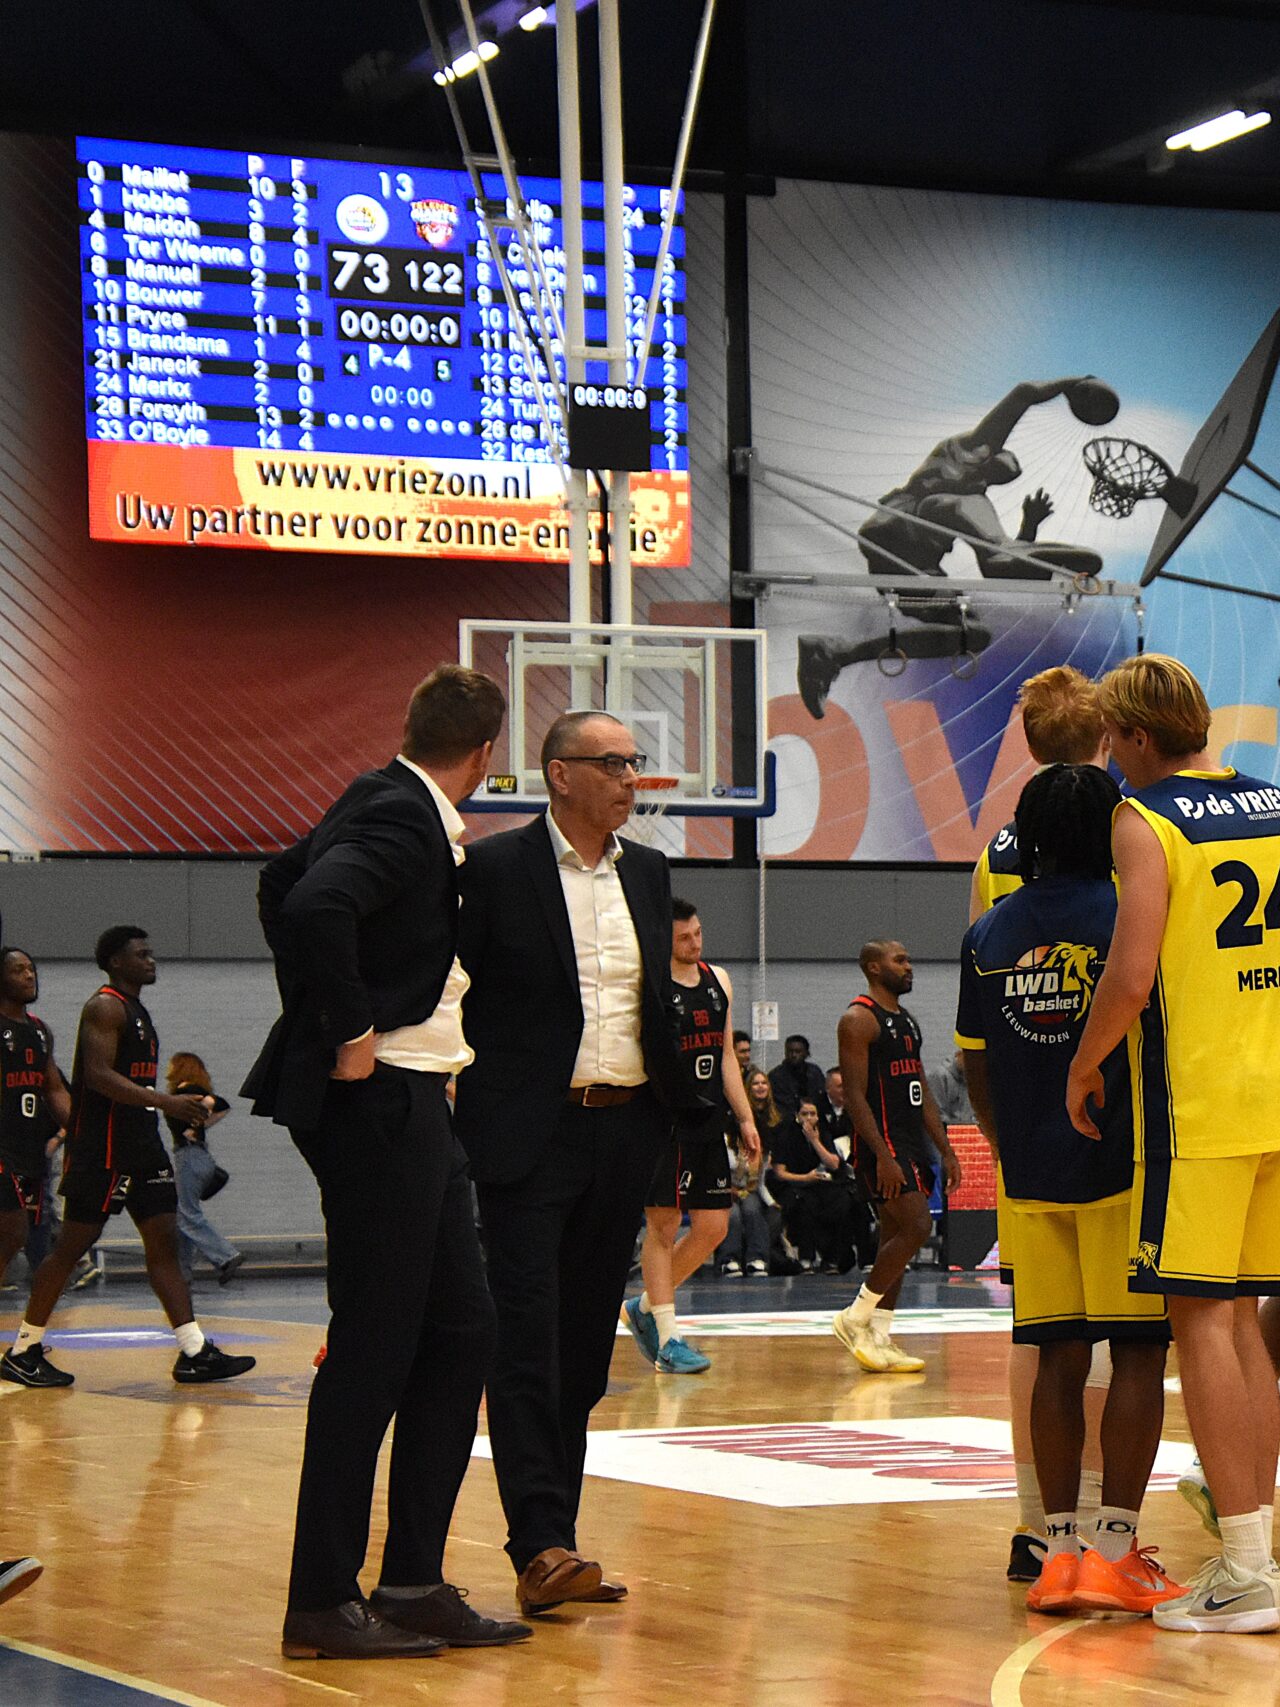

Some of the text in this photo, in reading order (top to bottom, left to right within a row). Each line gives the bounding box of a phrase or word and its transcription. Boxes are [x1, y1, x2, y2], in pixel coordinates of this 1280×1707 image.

[87, 160, 105, 185] 0
[248, 176, 276, 200] 10
[291, 179, 307, 202] 3
[247, 155, 306, 180] P F
[378, 171, 415, 202] 13
[90, 184, 309, 226] 1 Hobbs 3 2
[88, 207, 309, 248] 4 Maidoh 8 4
[123, 233, 162, 260] Ter
[250, 244, 266, 268] 0
[294, 249, 310, 272] 0
[90, 254, 308, 294] 8 Manuel 2 1
[331, 250, 463, 295] 73 122
[662, 275, 676, 298] 2
[94, 279, 311, 318] 10 Bouwer 7 3
[663, 297, 673, 318] 1
[95, 302, 310, 339] 11 Pryce 11 1
[340, 309, 460, 345] 00:00:0
[479, 307, 504, 331] 10
[663, 319, 673, 340] 1
[95, 326, 312, 361] 15 Brandsma 1 4
[480, 330, 502, 352] 11
[663, 340, 677, 362] 2
[94, 348, 313, 385] 21 Janeck 2 0
[345, 343, 452, 381] 4 P-4 5
[480, 352, 505, 374] 12
[663, 363, 677, 384] 2
[95, 372, 314, 407] 24 Merkx 2 0
[371, 385, 434, 408] 00:00
[480, 374, 678, 406] 13 2
[574, 386, 648, 411] 00:00:0
[96, 395, 315, 430] 28 Forsyth 13 2
[480, 396, 505, 419] 24
[664, 406, 678, 428] 2
[96, 418, 315, 453] 33 O'Boyle 14 4
[664, 428, 679, 450] 2
[481, 441, 676, 470] 32 1
[255, 459, 532, 501] www.vriezon.nl
[116, 490, 177, 532] Uw
[183, 503, 323, 548] partner
[331, 511, 407, 543] voor
[1205, 793, 1236, 816] de
[1005, 972, 1059, 997] LWD
[1023, 994, 1080, 1013] basket
[1001, 1004, 1070, 1044] LEEUWARDEN
